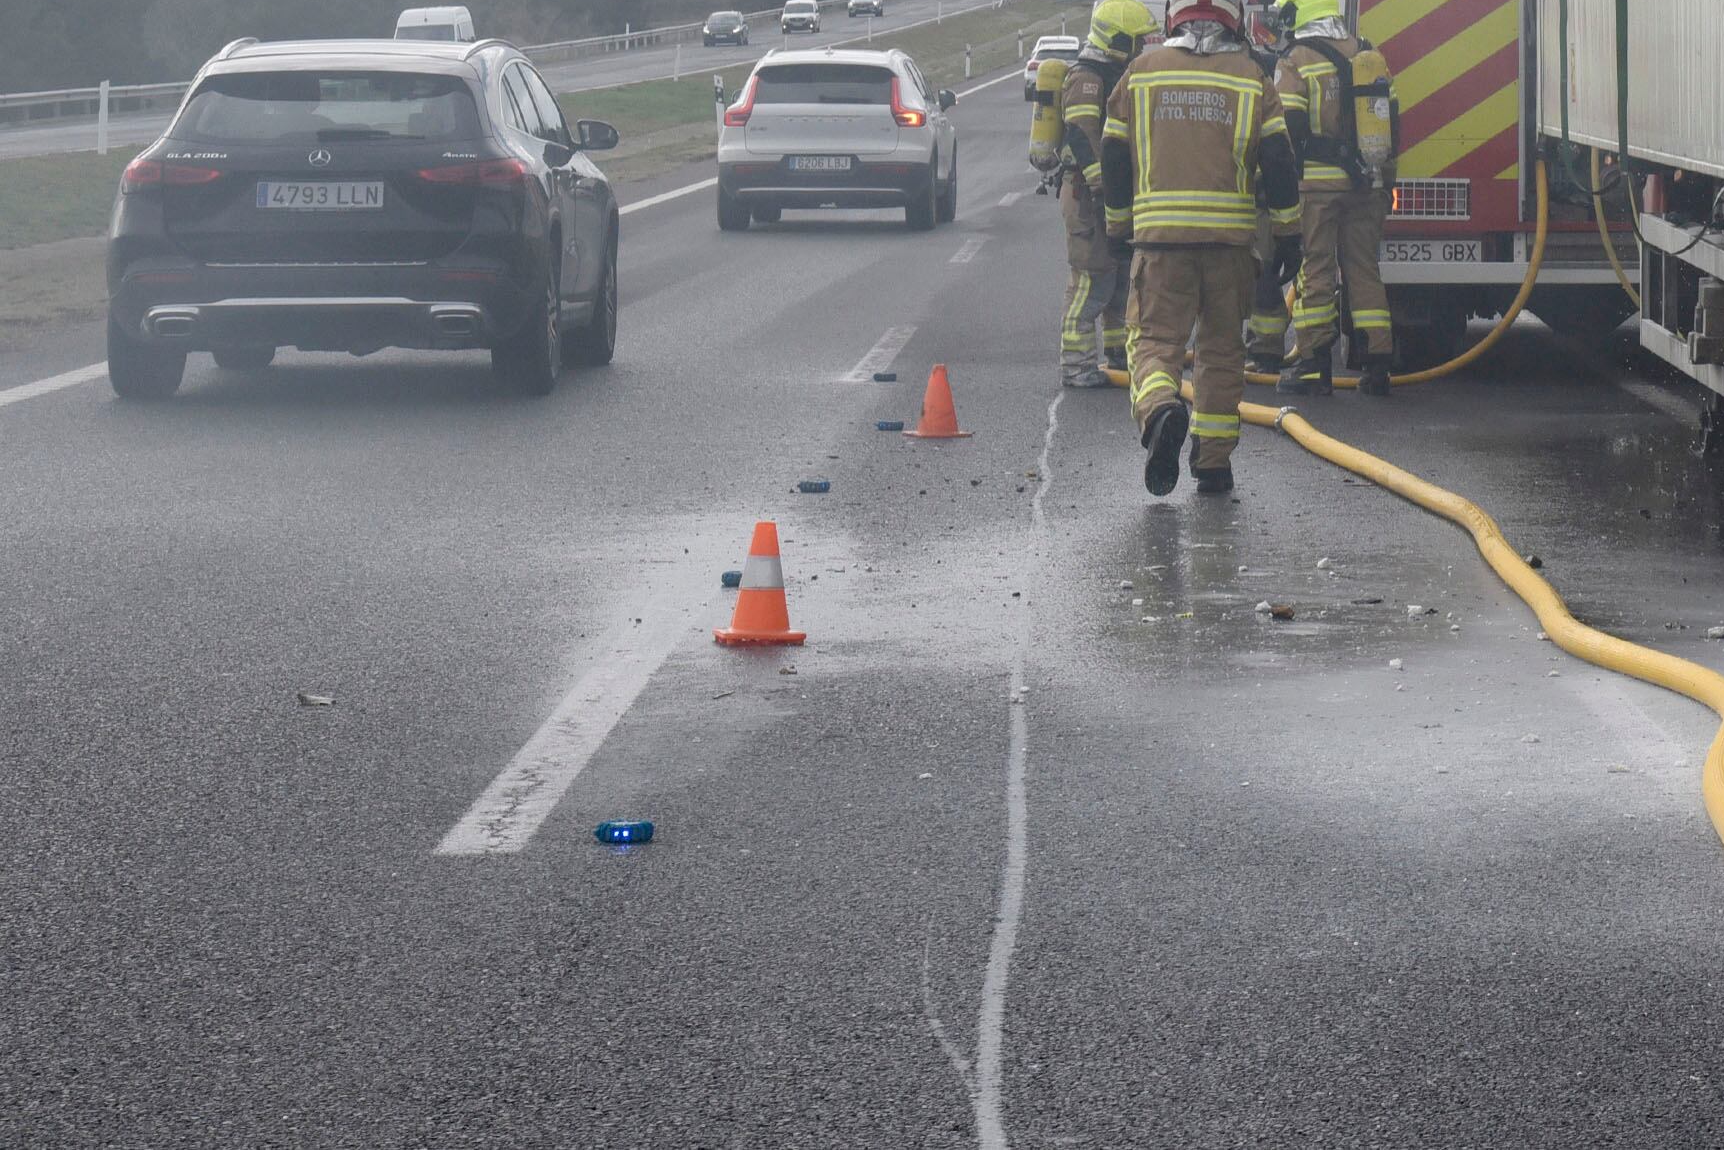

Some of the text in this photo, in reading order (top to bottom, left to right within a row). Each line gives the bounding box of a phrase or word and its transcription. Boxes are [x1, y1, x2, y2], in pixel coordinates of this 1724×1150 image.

[1161, 91, 1226, 107] BOMBEROS
[1189, 106, 1233, 125] HUESCA
[272, 185, 379, 204] 4793 LLN
[1386, 243, 1477, 262] 5525 GBX
